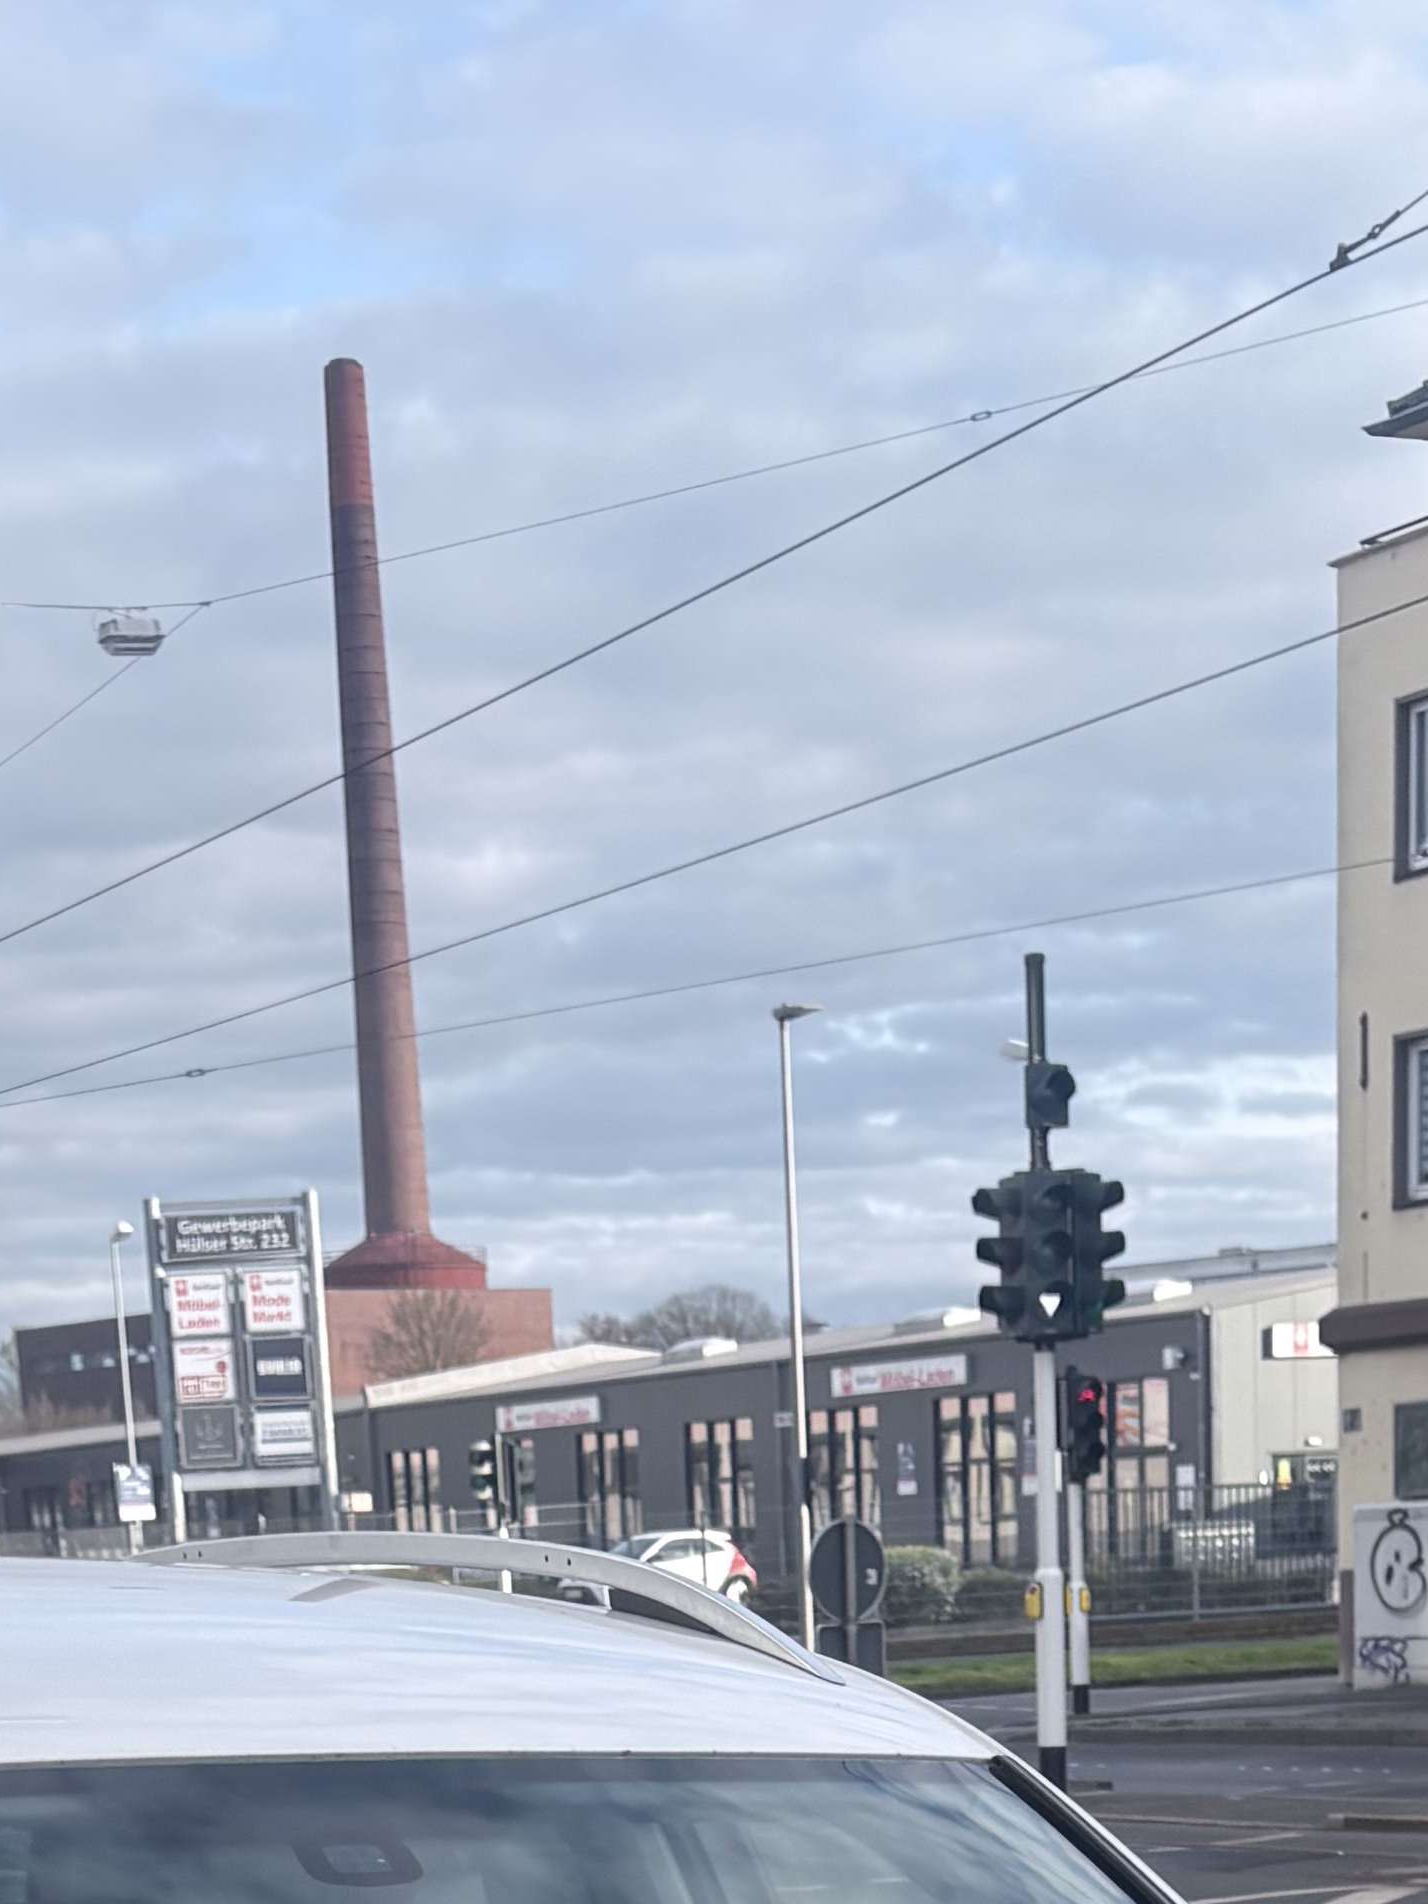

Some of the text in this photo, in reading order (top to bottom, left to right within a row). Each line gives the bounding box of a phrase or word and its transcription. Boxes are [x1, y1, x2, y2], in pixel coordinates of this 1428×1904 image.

[177, 1214, 286, 1236] Gewerbepark
[230, 1235, 258, 1251] Str.
[260, 1232, 292, 1250] 232
